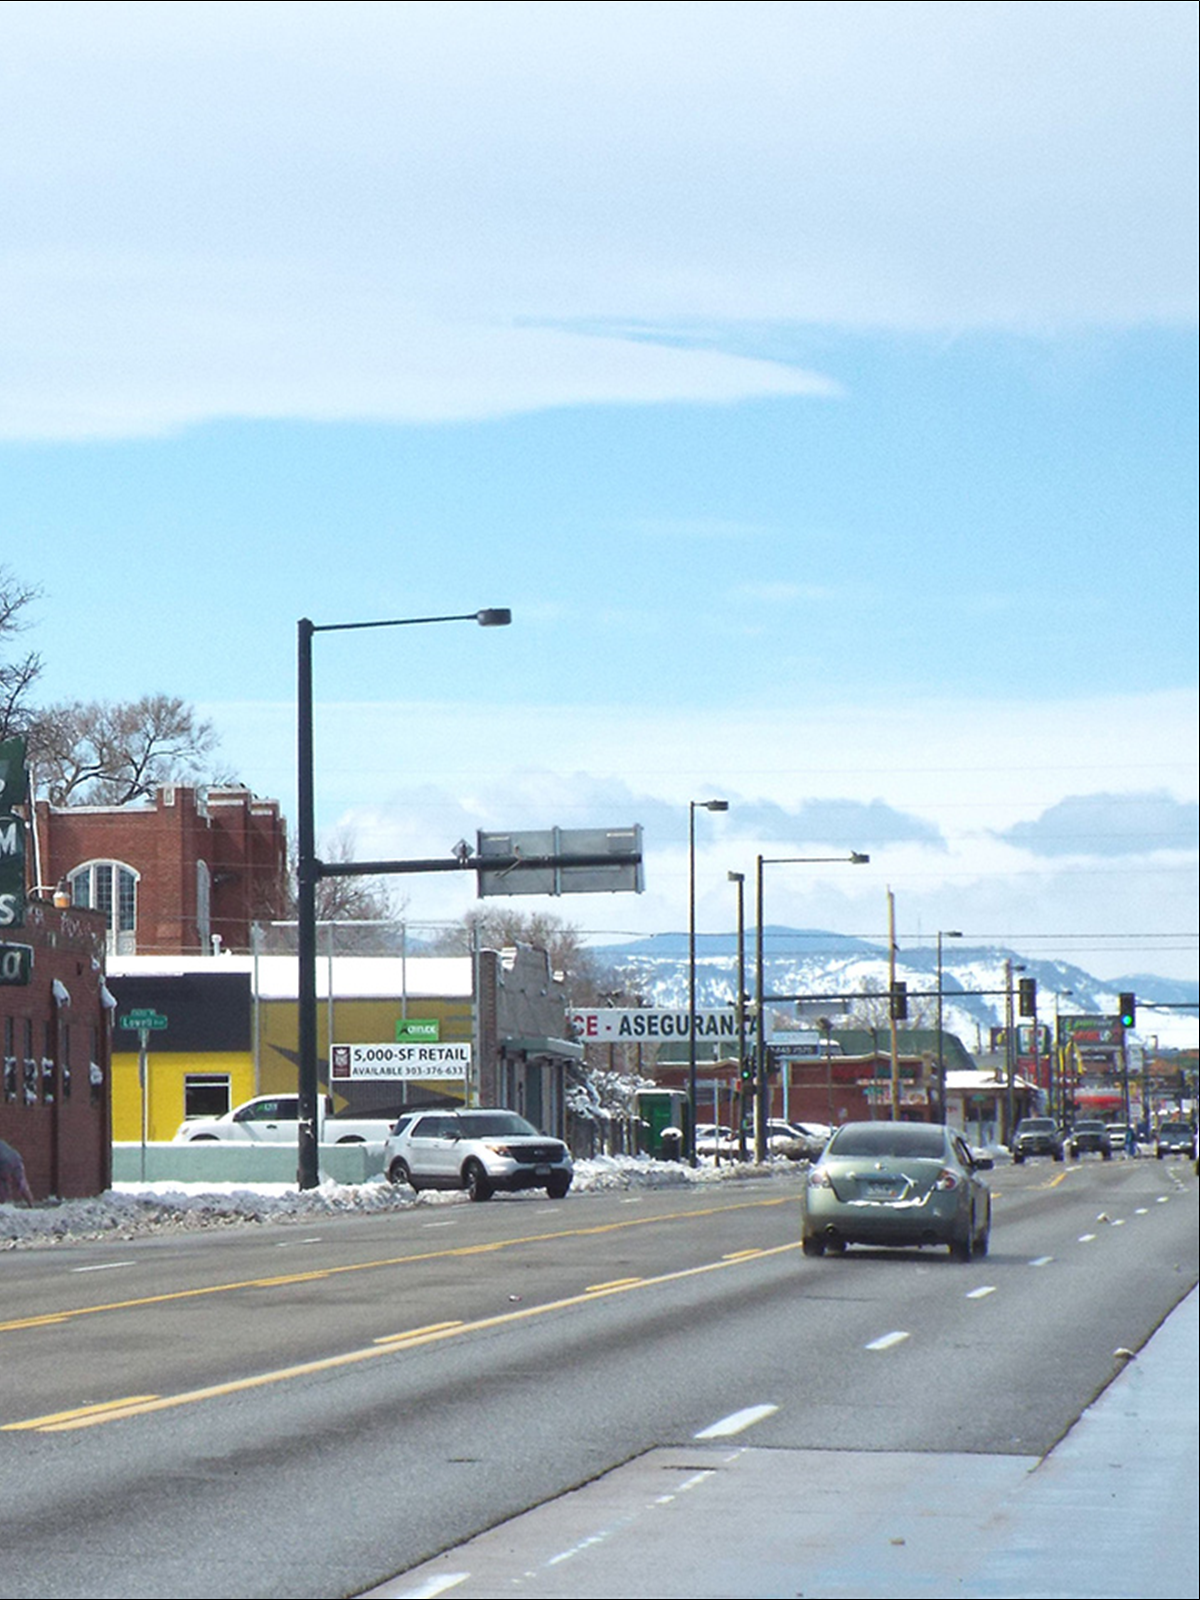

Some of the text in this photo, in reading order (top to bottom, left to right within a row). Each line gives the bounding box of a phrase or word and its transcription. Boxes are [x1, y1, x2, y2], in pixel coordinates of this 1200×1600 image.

[354, 1048, 467, 1062] 5,000-SF RETAIL
[352, 1066, 402, 1075] AVAILABLE
